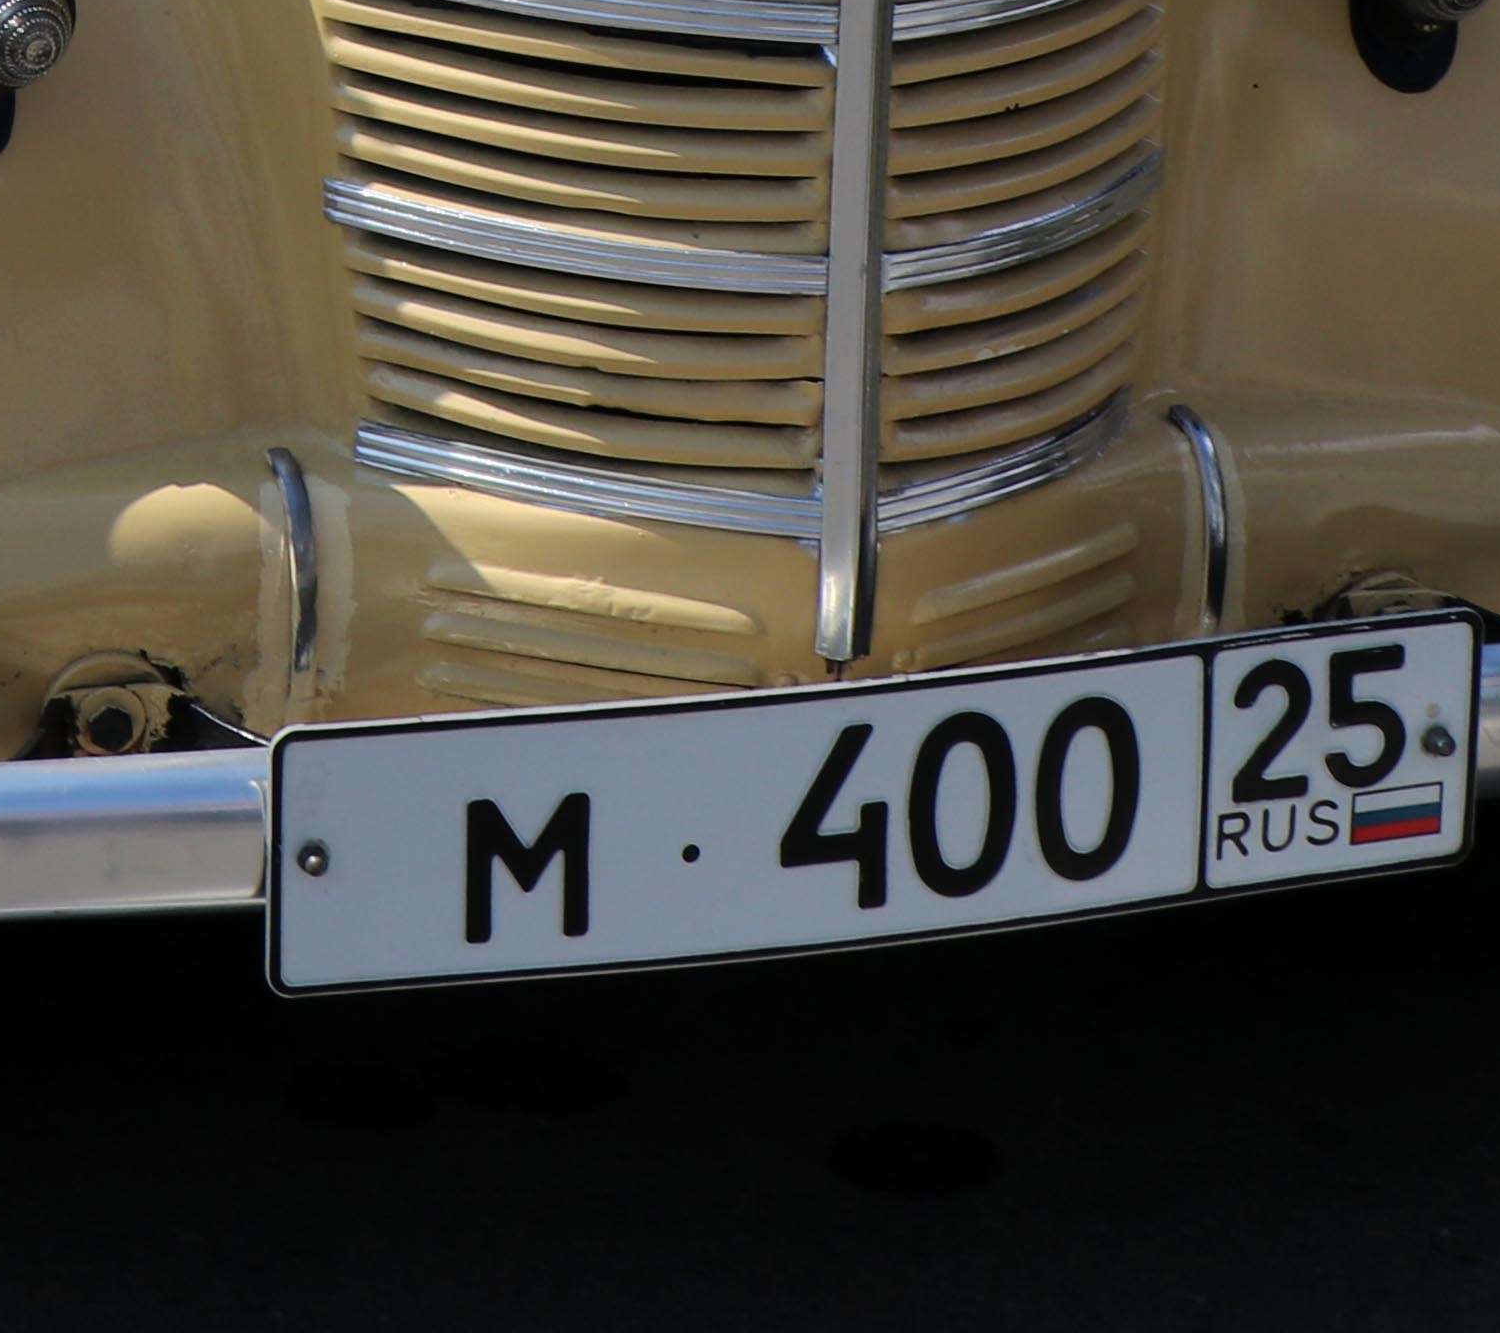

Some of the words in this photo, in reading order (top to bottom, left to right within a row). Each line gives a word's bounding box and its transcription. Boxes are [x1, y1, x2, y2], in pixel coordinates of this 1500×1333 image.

[1231, 641, 1409, 805] 25
[460, 789, 594, 947] М
[777, 693, 1141, 913] 400
[1215, 798, 1341, 863] RUS
